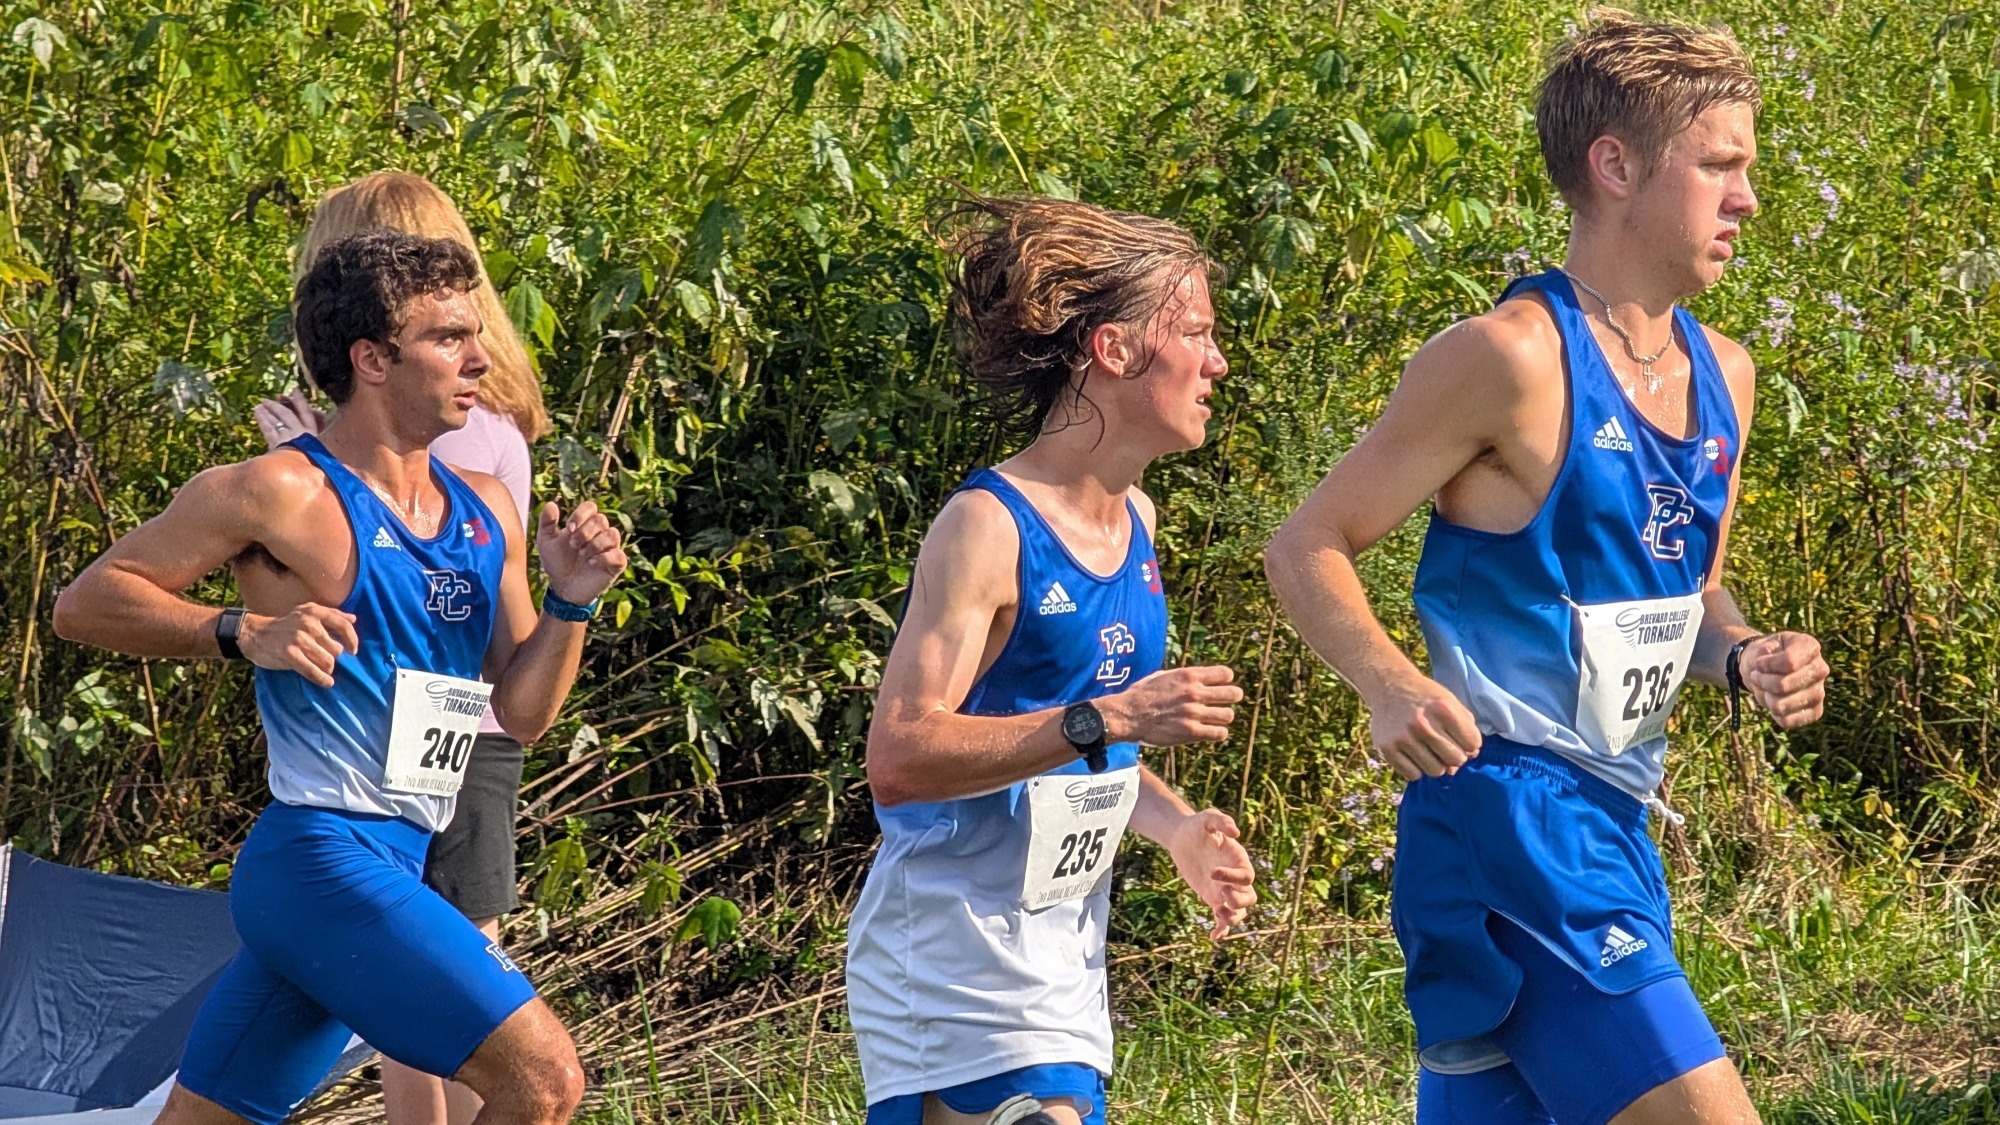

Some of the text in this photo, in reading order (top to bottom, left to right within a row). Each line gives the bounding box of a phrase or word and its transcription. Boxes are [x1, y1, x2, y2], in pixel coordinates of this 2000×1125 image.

[1593, 436, 1634, 453] adidas
[1039, 602, 1077, 616] adidas
[1639, 608, 1691, 626] BREVARD COLLEGE
[1637, 621, 1687, 646] TORNADOS
[1622, 661, 1674, 721] 236
[443, 697, 487, 718] TORNADOS
[419, 727, 473, 773] 240
[1080, 791, 1122, 814] TORNADOS
[1051, 827, 1109, 880] 235
[1600, 939, 1648, 968] adidas
